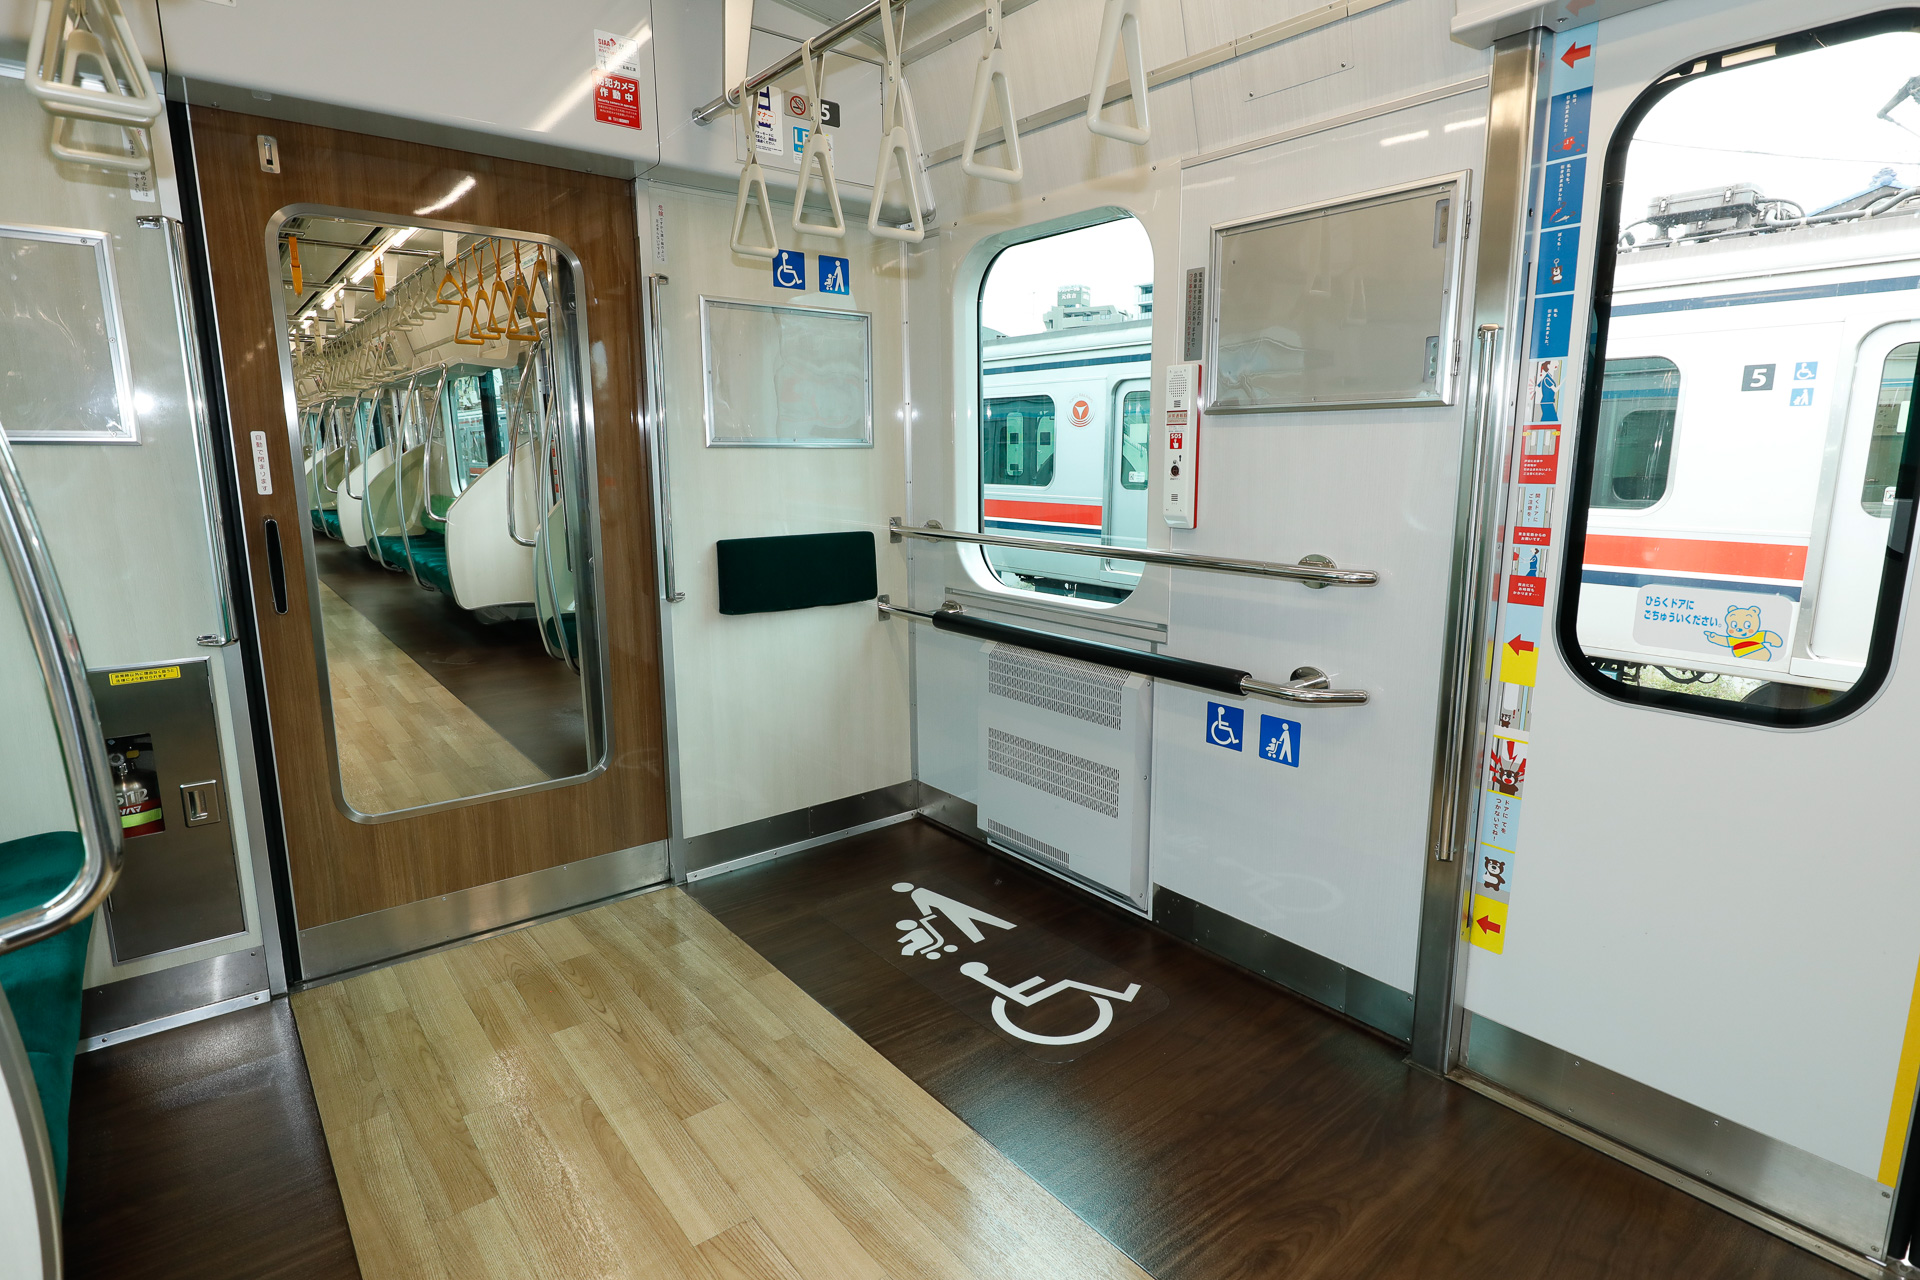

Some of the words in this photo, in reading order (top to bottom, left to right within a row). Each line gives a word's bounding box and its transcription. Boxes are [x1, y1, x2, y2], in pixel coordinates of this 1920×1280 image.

[597, 38, 610, 47] SIAA
[596, 75, 636, 93] 防犯カメラ
[599, 87, 634, 103] 作動中
[821, 103, 831, 121] 5
[1749, 368, 1768, 388] 5
[255, 434, 268, 492] 自動で閉まります
[1533, 493, 1541, 523] 開くドアに
[1645, 595, 1695, 610] ひらくドアに
[1643, 609, 1723, 628] ごちゅういください。
[1502, 799, 1510, 819] ドアに
[1492, 798, 1502, 842] つかないでね！
[1501, 821, 1508, 835] てを
